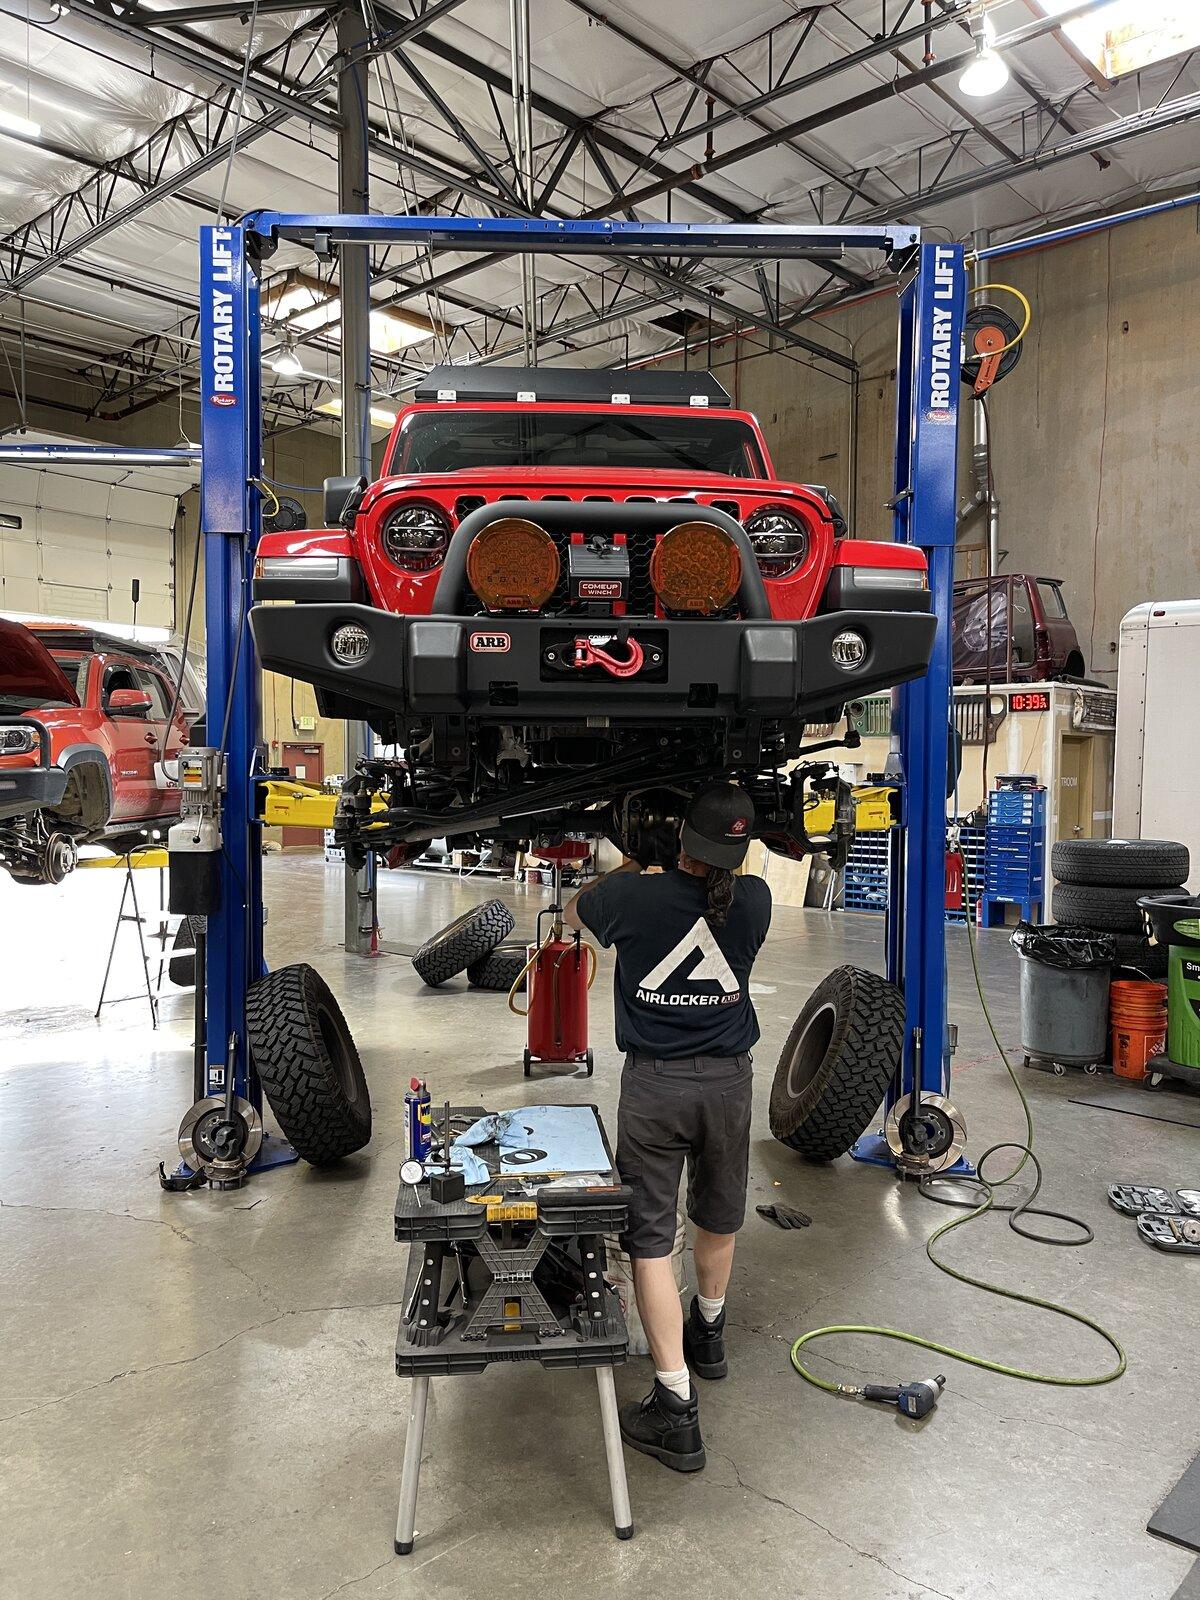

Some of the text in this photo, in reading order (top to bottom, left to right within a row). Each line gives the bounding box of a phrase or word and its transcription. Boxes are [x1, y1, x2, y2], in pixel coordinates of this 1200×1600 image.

[212, 227, 234, 392] ROTARY LIFT
[930, 246, 955, 408] ROTARY LIFT
[475, 636, 507, 648] ARB
[1012, 694, 1040, 709] 10:39
[635, 989, 720, 1006] AIRLOCKER
